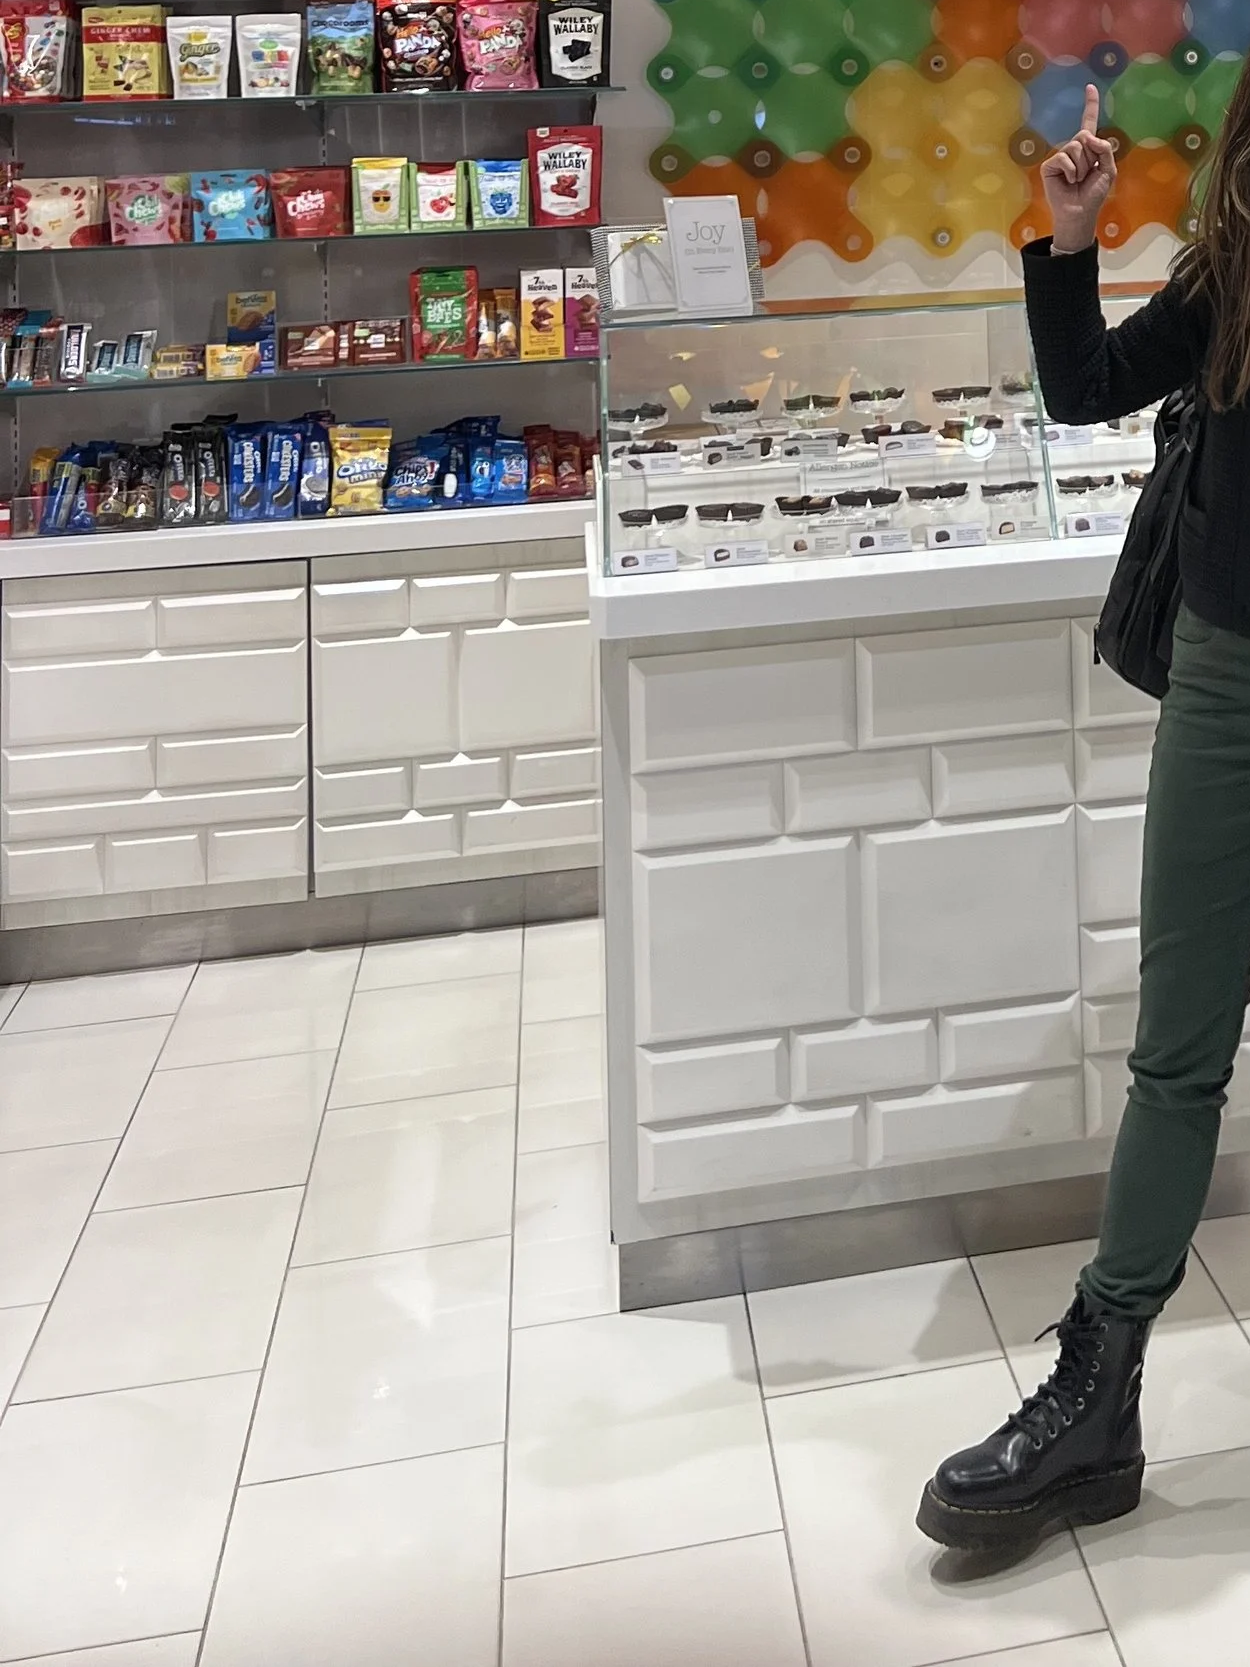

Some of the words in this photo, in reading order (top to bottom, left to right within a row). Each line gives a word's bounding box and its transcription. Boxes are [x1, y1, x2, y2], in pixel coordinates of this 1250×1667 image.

[558, 16, 594, 24] WILEY
[553, 23, 599, 35] WALLABY
[394, 33, 442, 54] PANDA
[479, 33, 523, 54] PANDA
[179, 42, 221, 62] Ginger
[547, 151, 582, 160] WILEY
[543, 158, 587, 171] WALLABY
[686, 221, 726, 245] Joy
[527, 283, 558, 292] Heaven
[427, 297, 456, 310] TINY
[426, 306, 462, 324] BITES
[173, 454, 185, 481] OREO
[338, 458, 388, 477] OREO
[808, 462, 850, 472] Allergen
[850, 460, 880, 470] Notice
